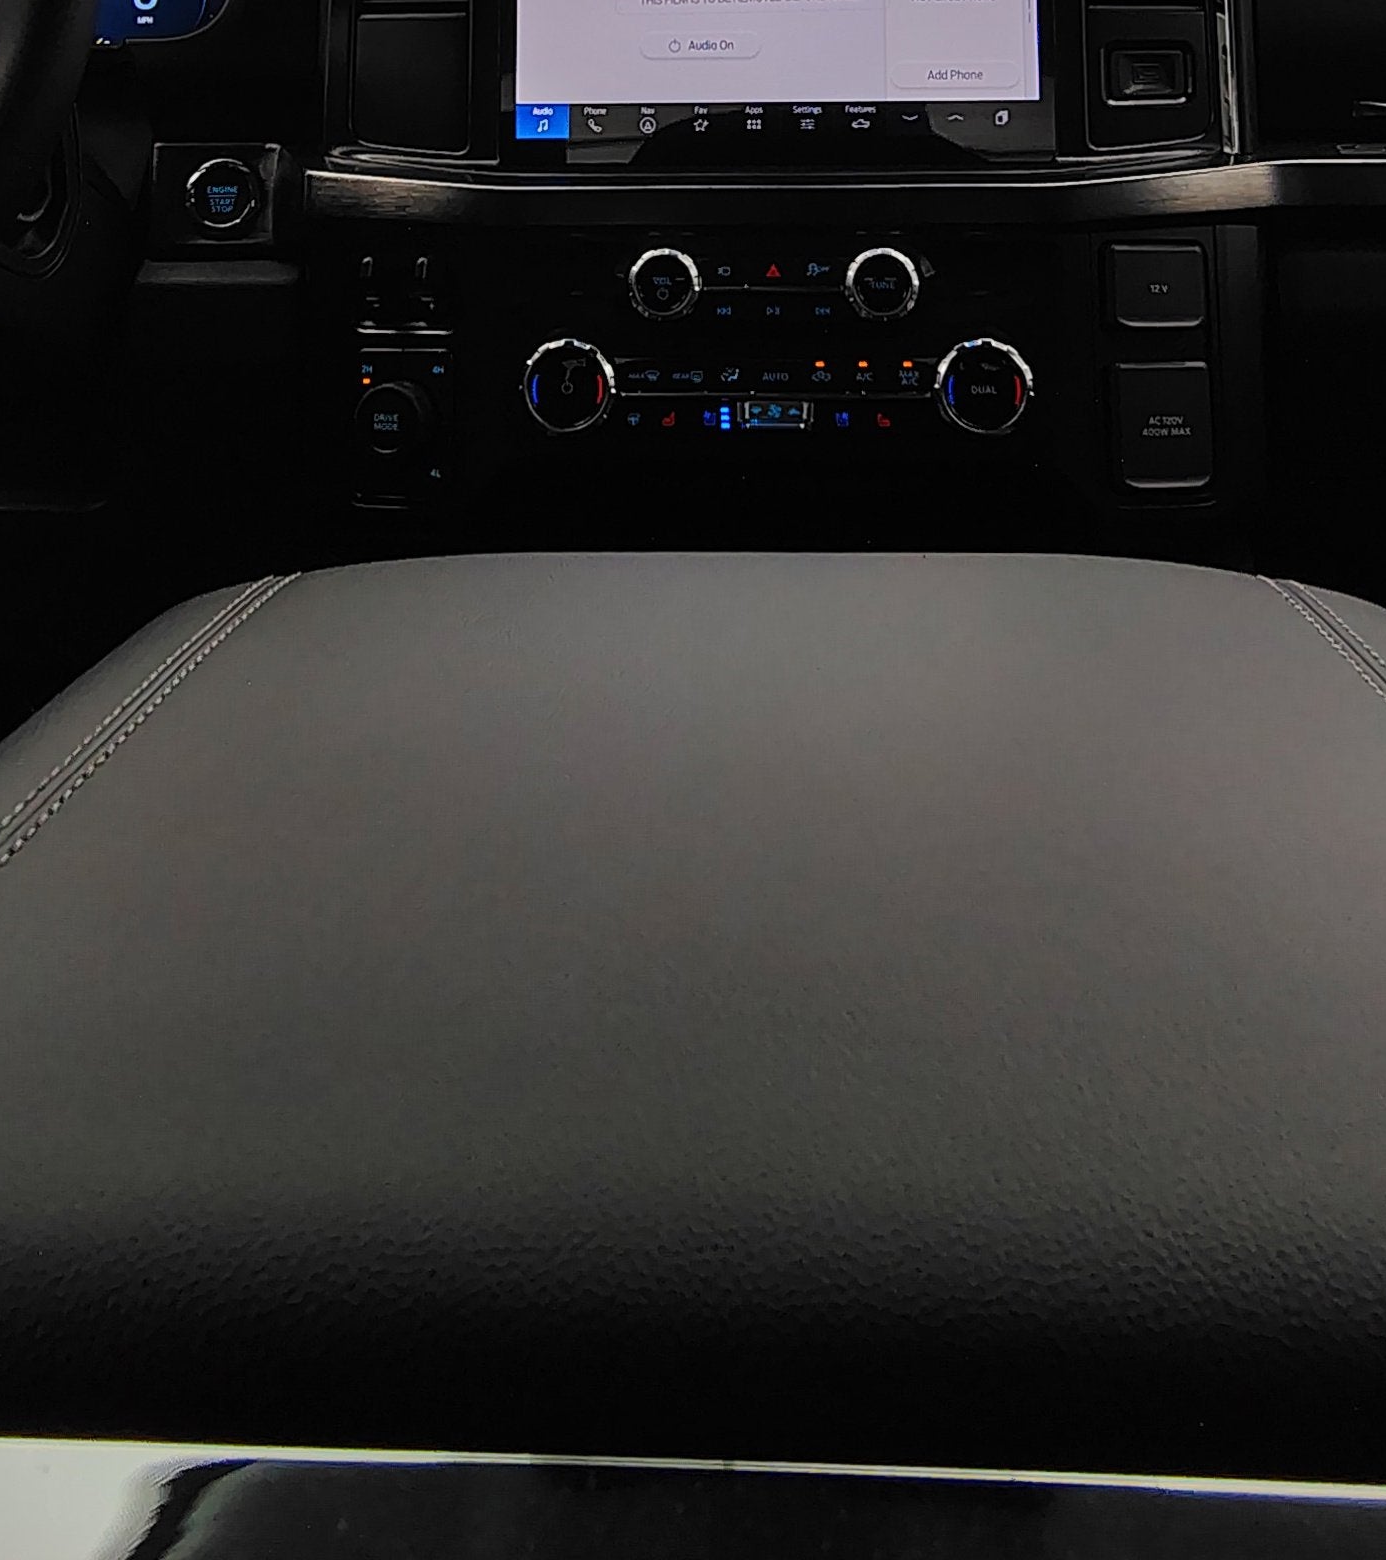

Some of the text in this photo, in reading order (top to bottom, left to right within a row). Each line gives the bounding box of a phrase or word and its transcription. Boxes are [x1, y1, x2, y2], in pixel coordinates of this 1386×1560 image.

[688, 41, 734, 51] Audio On
[927, 70, 983, 80] Add Phone
[533, 107, 553, 116] Audio
[583, 106, 607, 116] Phone
[694, 106, 708, 115] Fav
[744, 106, 763, 117] Apps
[792, 105, 822, 116] Settings
[207, 185, 239, 194] ENGINE
[210, 198, 235, 206] START
[211, 205, 234, 213] STOP
[762, 371, 789, 382] AUTO
[856, 372, 874, 382] A/C
[971, 385, 997, 395] DUAL
[373, 413, 399, 422] DRIVE
[1148, 416, 1161, 426] AC
[1171, 427, 1192, 437] MAX
